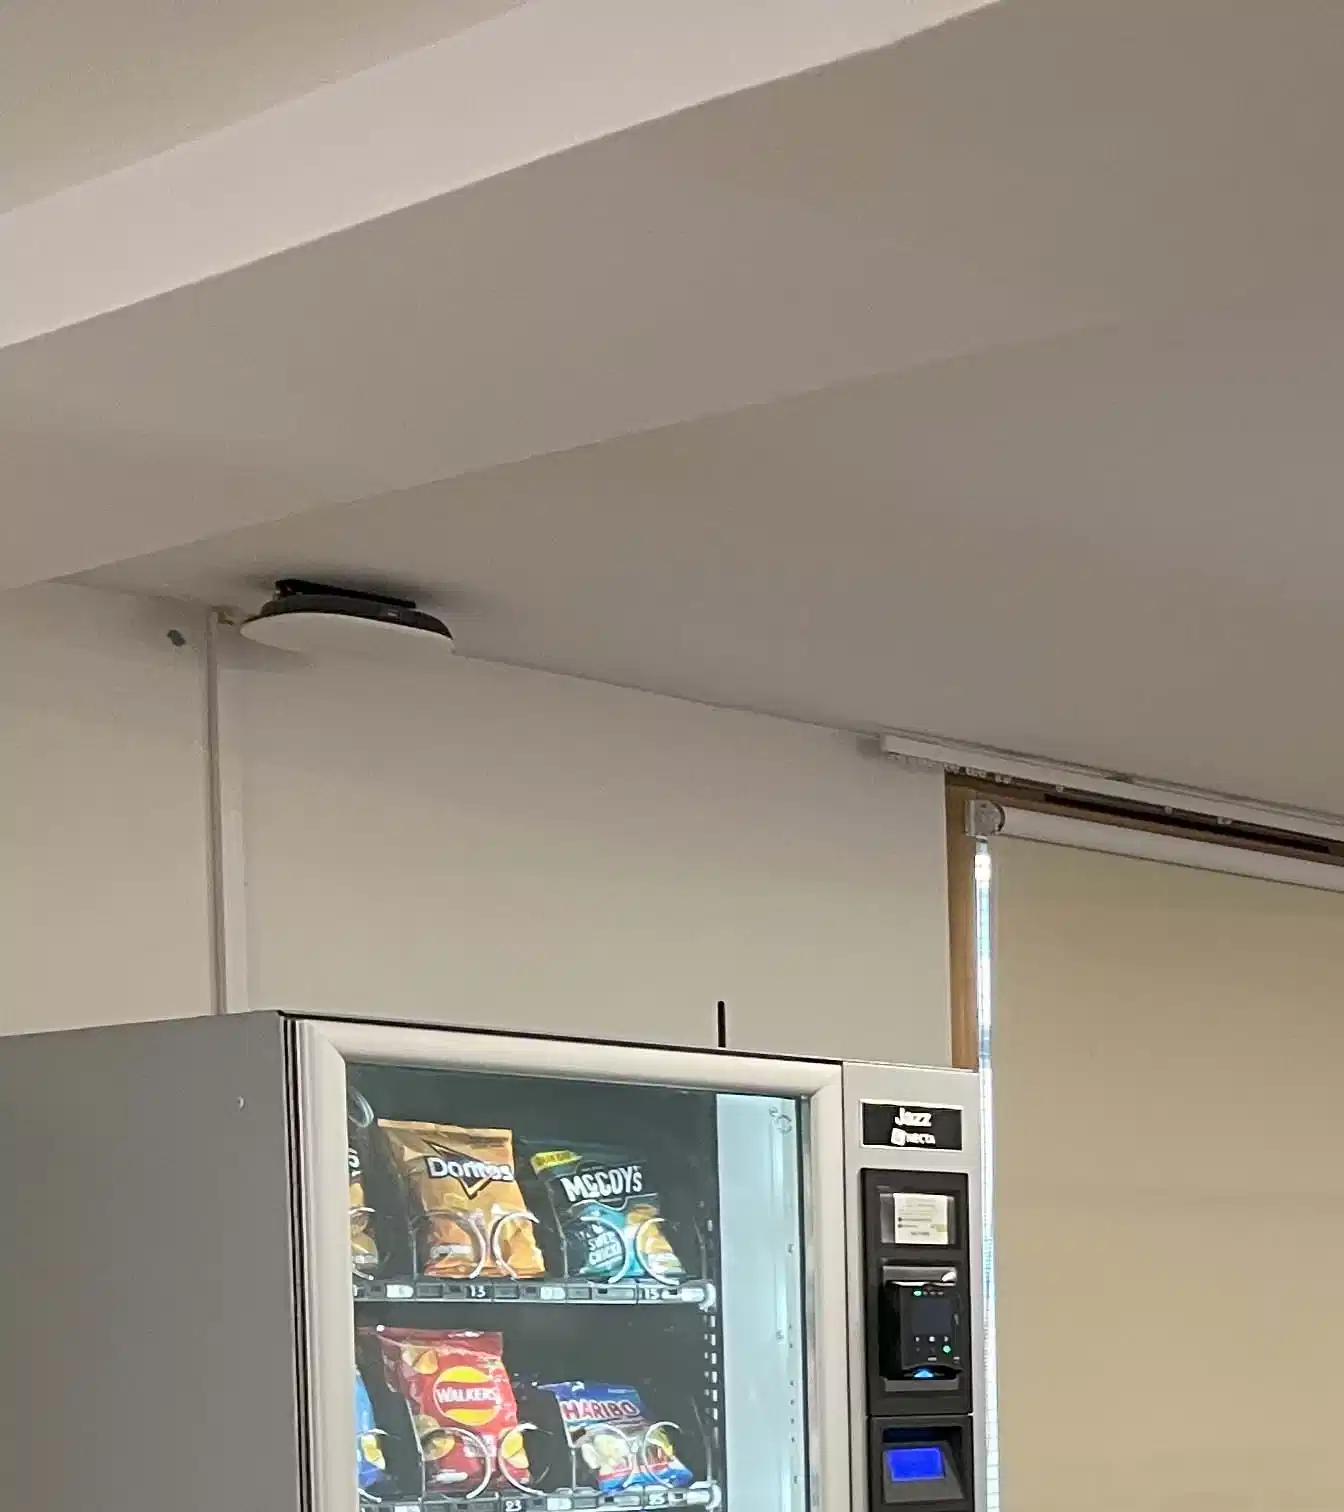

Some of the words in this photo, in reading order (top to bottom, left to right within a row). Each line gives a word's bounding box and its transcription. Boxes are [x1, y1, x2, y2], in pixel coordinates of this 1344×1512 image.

[470, 1285, 487, 1298] 13
[435, 1386, 500, 1404] WALKERS
[561, 1400, 640, 1420] HARIBO
[504, 1500, 523, 1512] 23
